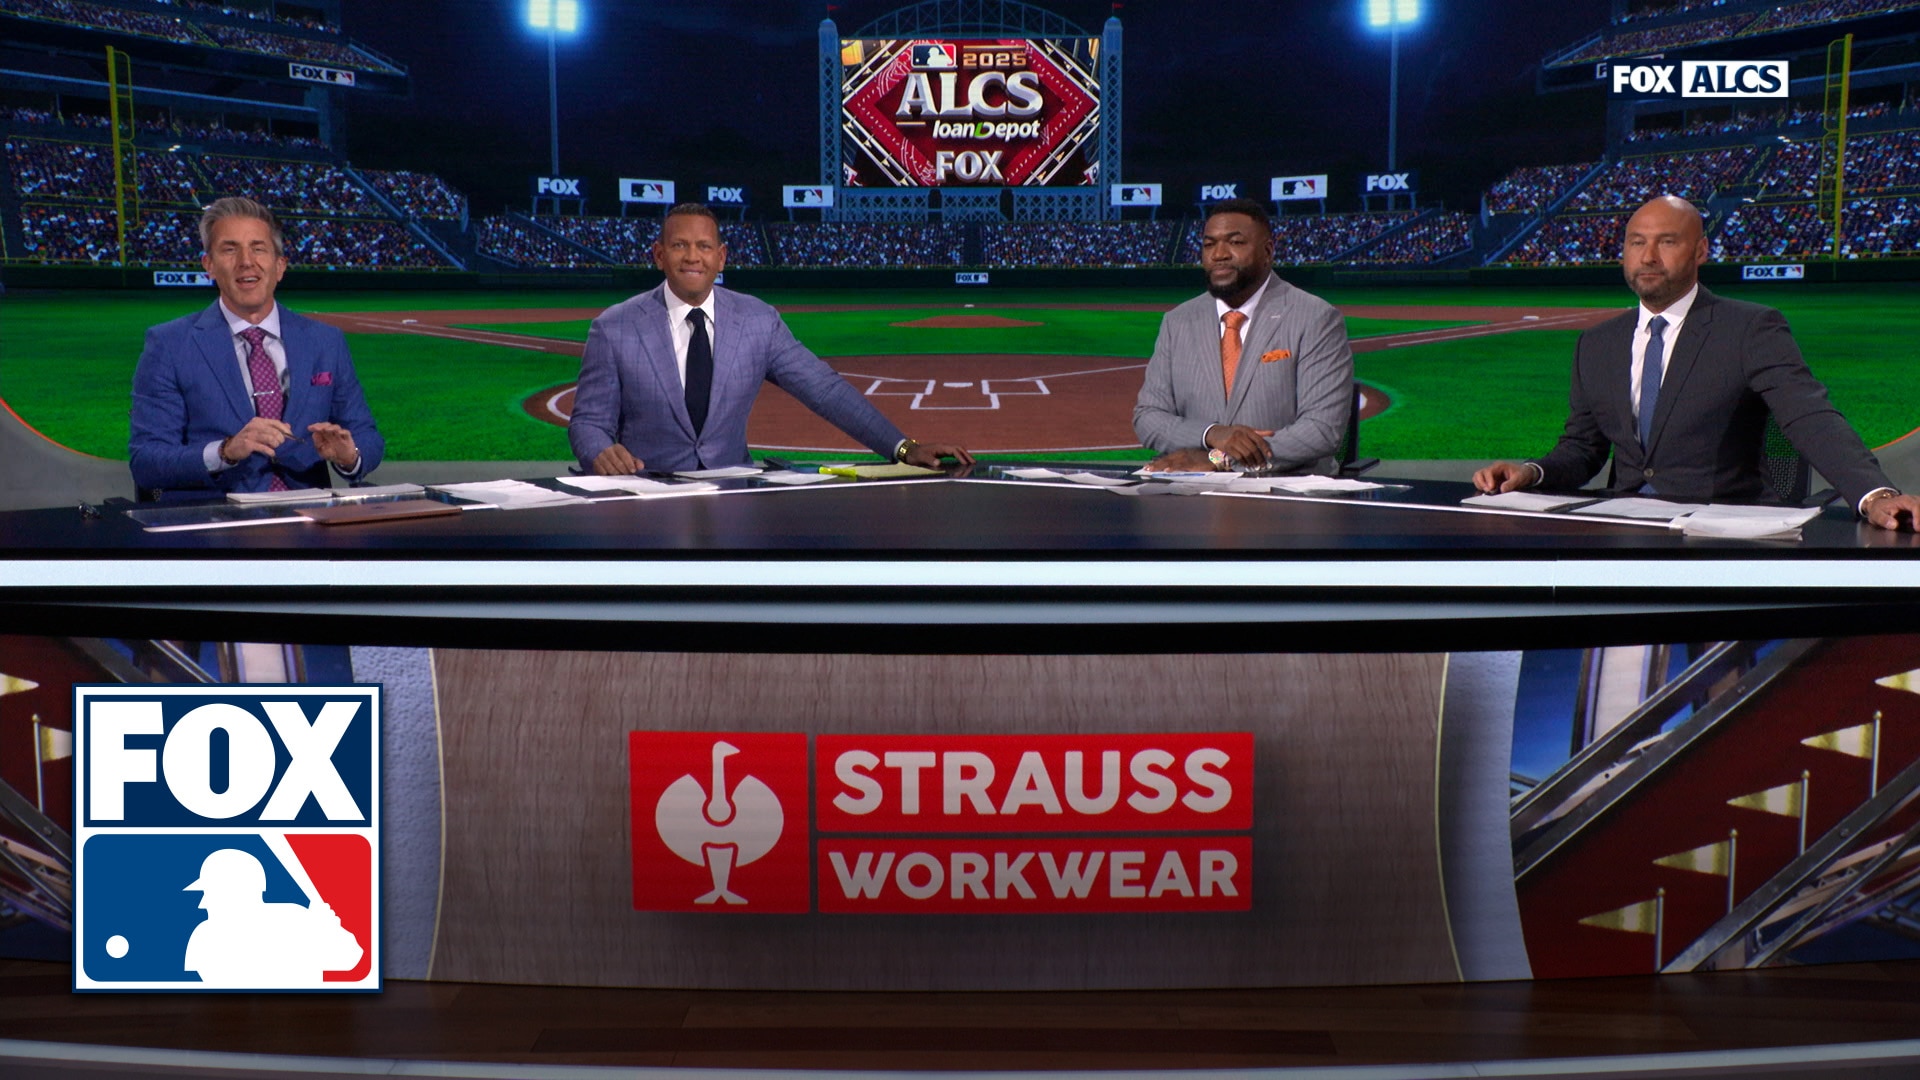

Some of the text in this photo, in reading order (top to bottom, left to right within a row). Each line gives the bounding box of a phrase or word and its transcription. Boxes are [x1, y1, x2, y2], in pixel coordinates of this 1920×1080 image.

[963, 53, 1026, 67] 2025
[291, 64, 323, 80] FOX
[895, 71, 1043, 117] ALCS
[932, 120, 1041, 141] loanDepot
[935, 150, 1003, 183] FOX
[537, 177, 580, 195] FOX
[1366, 173, 1409, 191] FOX
[707, 187, 743, 202] FOX
[1201, 184, 1237, 200] FOX
[155, 273, 185, 284] FOX
[1745, 267, 1775, 278] FOX
[832, 747, 1234, 815] STRAUSS
[828, 850, 1239, 900] WORKWEAR
